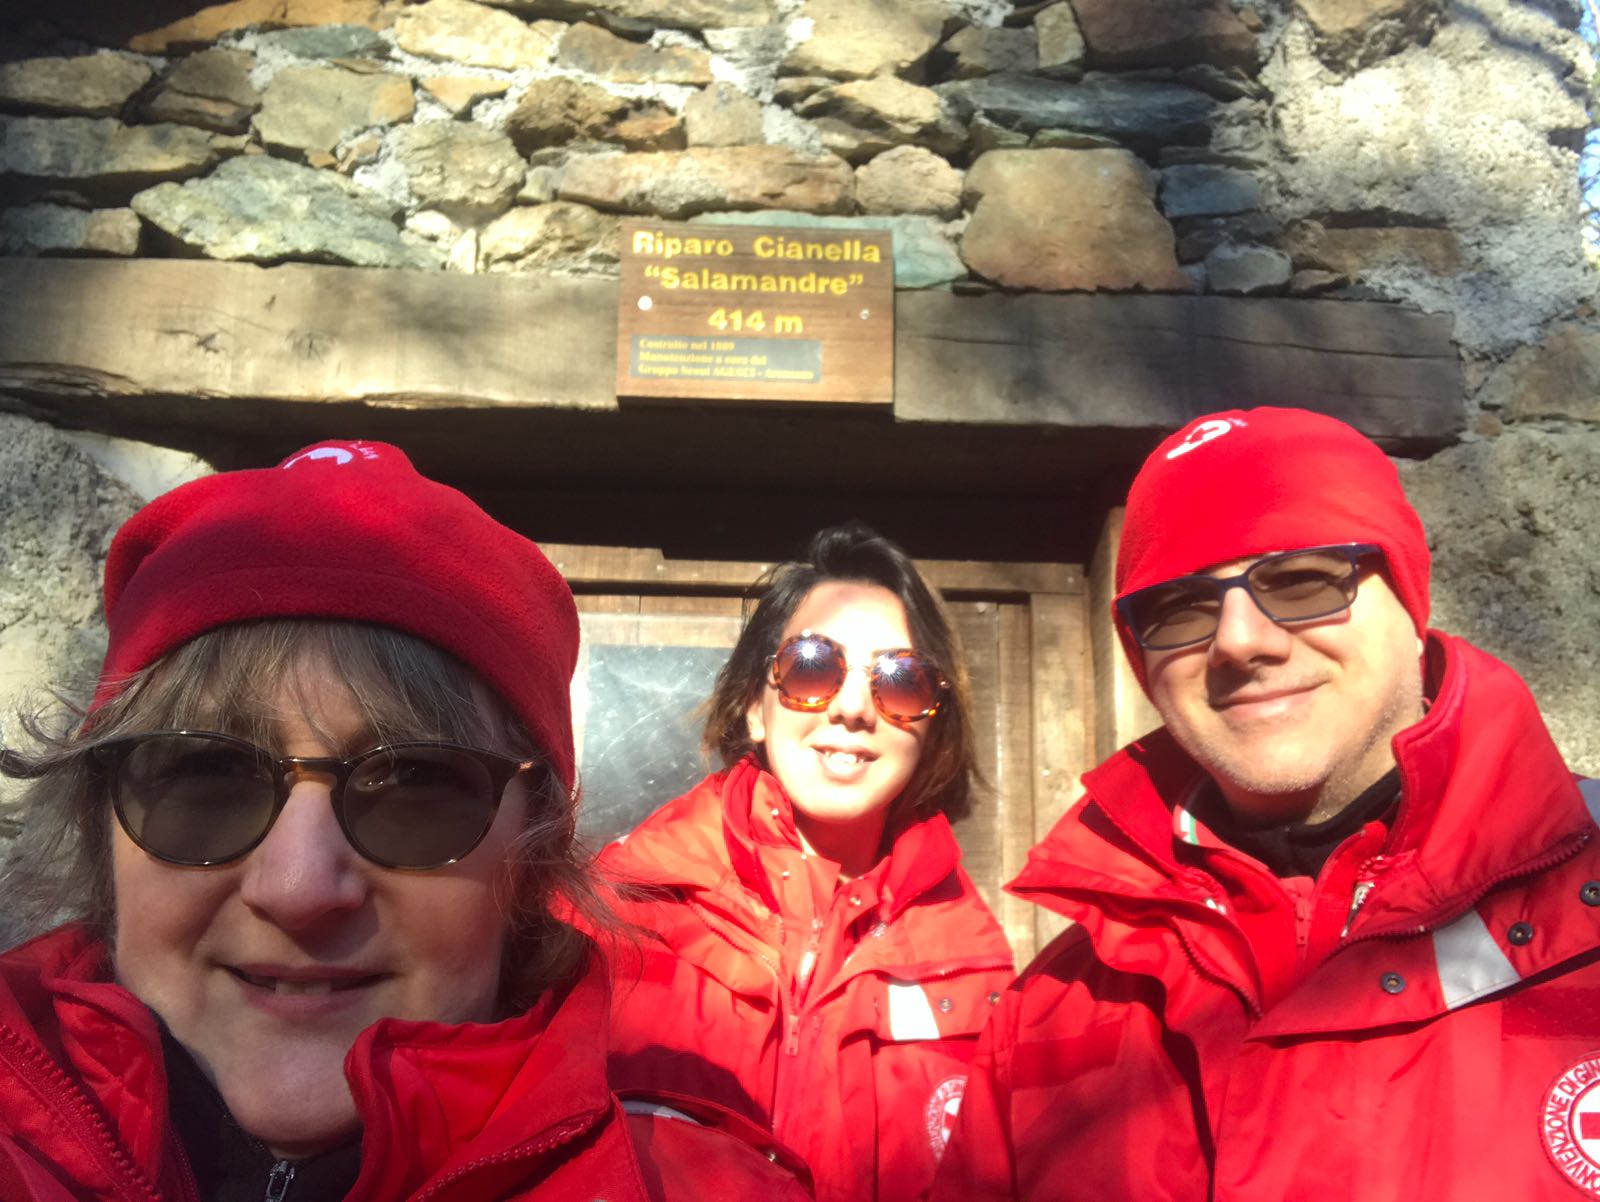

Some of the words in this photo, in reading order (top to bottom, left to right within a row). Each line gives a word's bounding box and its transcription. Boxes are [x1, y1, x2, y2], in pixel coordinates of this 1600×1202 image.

[632, 230, 734, 259] Riparo
[753, 235, 881, 263] Cianella
[708, 308, 766, 332] 414
[774, 313, 803, 334] m
[1547, 1094, 1600, 1191] ONVENZIONE
